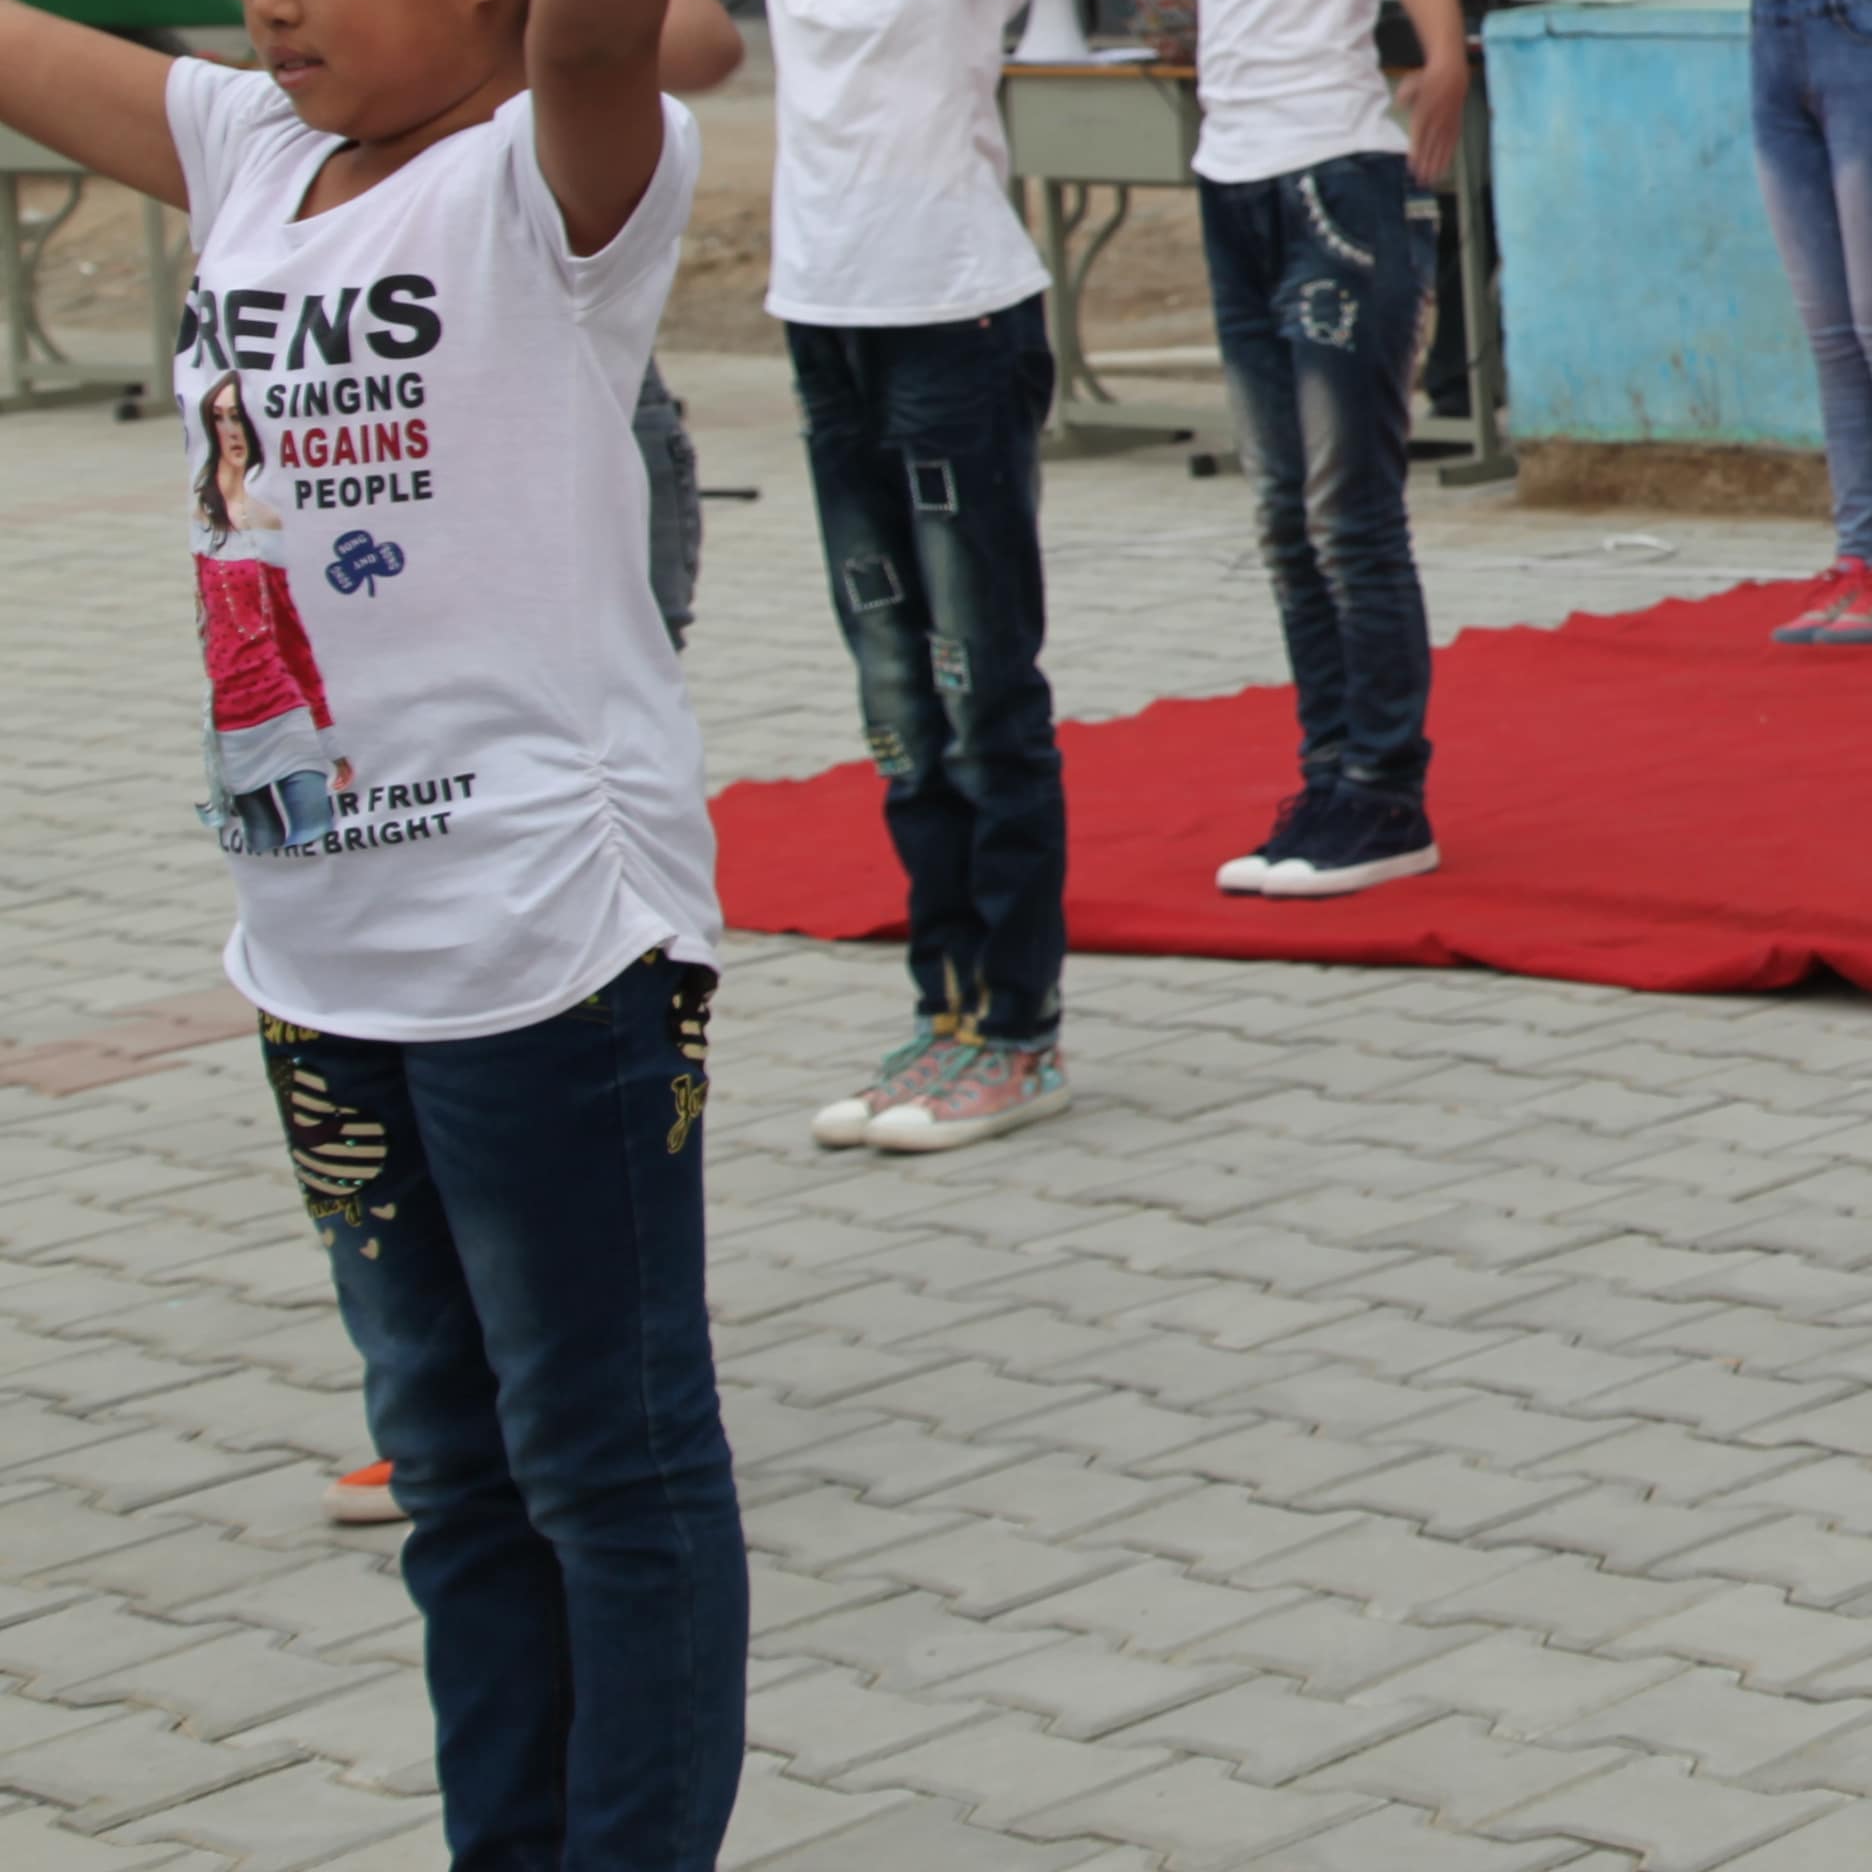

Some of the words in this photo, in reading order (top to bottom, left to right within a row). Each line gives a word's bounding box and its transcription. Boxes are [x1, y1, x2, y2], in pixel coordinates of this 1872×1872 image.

[264, 371, 426, 419] SINGNG
[279, 419, 430, 470] AGAINS
[294, 469, 434, 510] PEOPLE
[367, 772, 478, 813] FRUIT
[323, 811, 453, 855] BRIGHT
